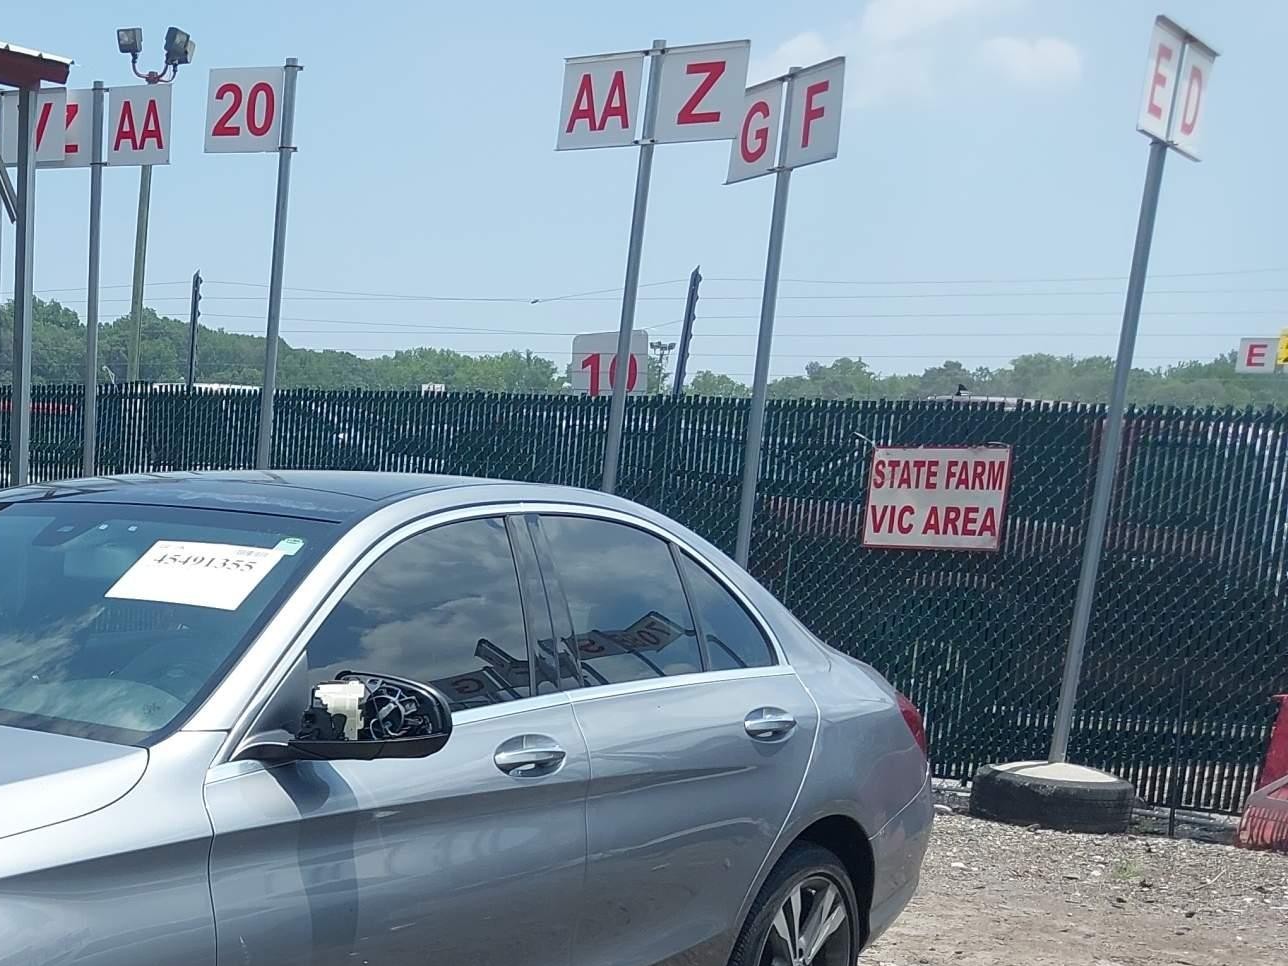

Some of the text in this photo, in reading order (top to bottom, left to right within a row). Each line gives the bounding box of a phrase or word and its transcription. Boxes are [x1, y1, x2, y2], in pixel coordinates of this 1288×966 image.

[212, 82, 275, 137] 20
[565, 70, 629, 133] AA
[676, 60, 726, 125] Z
[1147, 43, 1173, 120] E
[1180, 65, 1204, 136] D
[114, 99, 164, 151] AA
[740, 101, 770, 163] G
[800, 80, 830, 148] F
[1246, 343, 1268, 367] E
[872, 459, 1006, 491] STATE FARM
[870, 504, 997, 537] VIC AREA
[153, 552, 257, 573] 45491355
